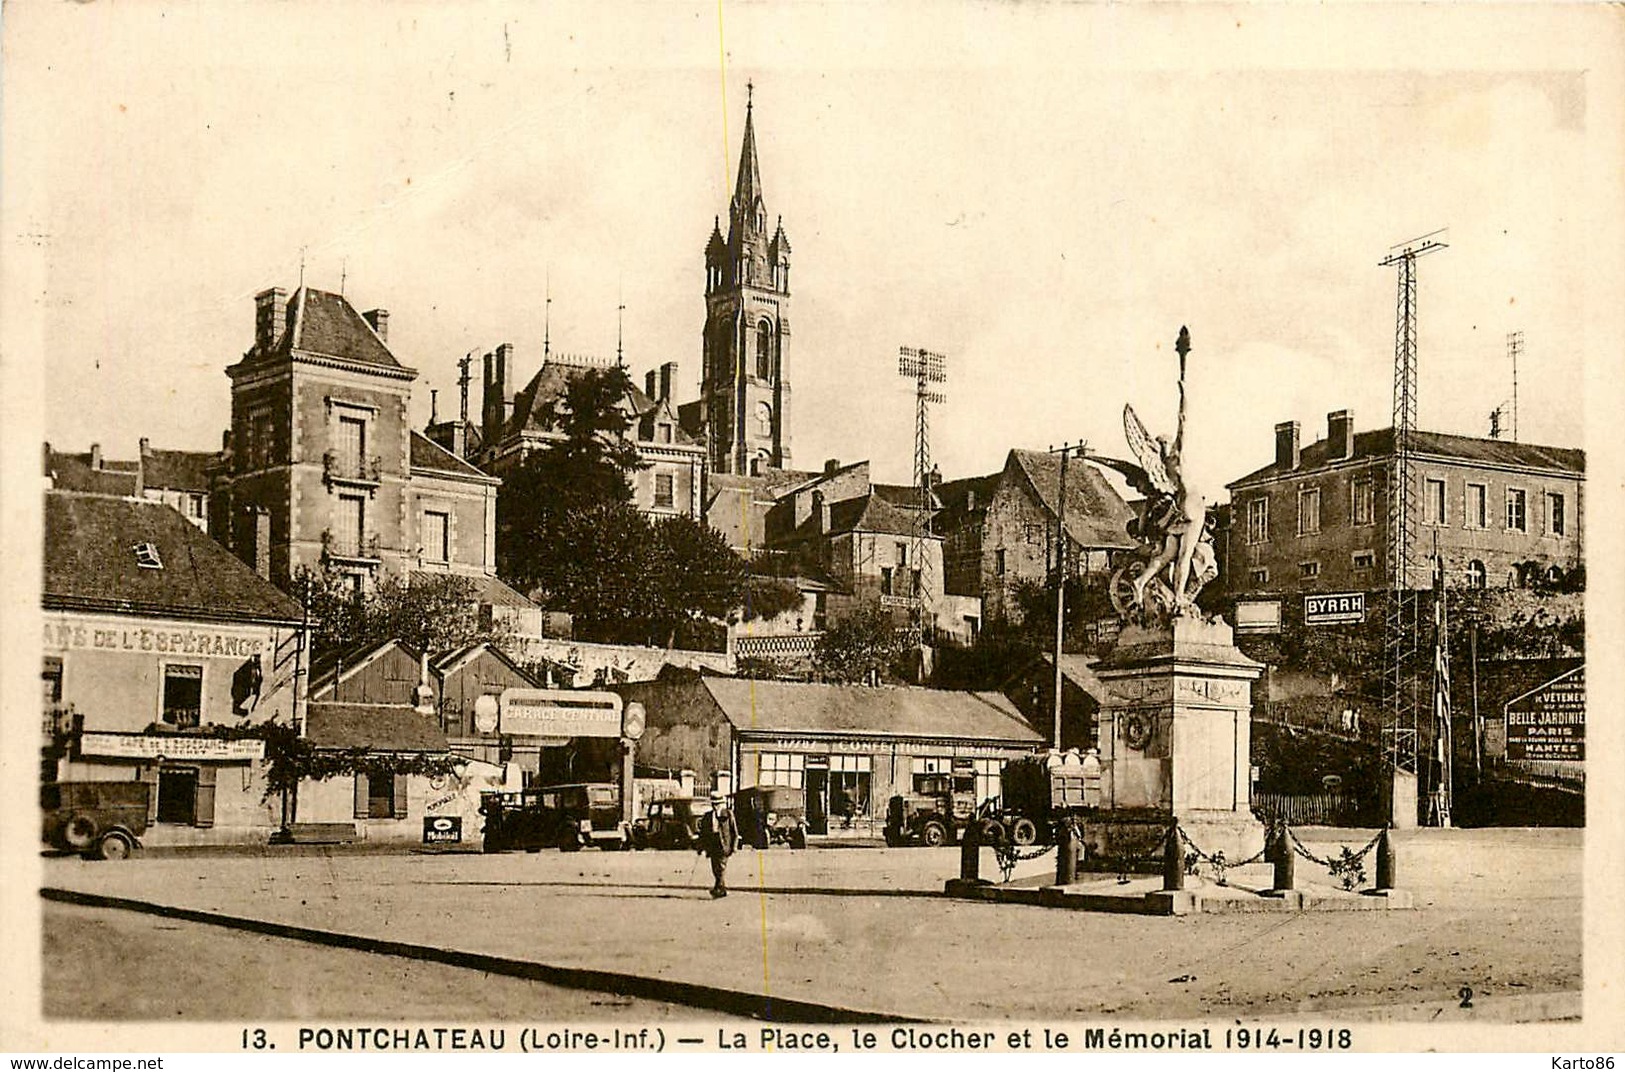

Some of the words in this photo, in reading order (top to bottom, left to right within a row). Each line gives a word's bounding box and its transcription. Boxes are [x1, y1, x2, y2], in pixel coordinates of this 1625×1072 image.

[1308, 598, 1361, 613] BYRRH
[94, 629, 117, 648] DE
[1509, 711, 1537, 725] BELLE
[1528, 727, 1573, 736] PARIS
[1525, 744, 1578, 753] NANTES
